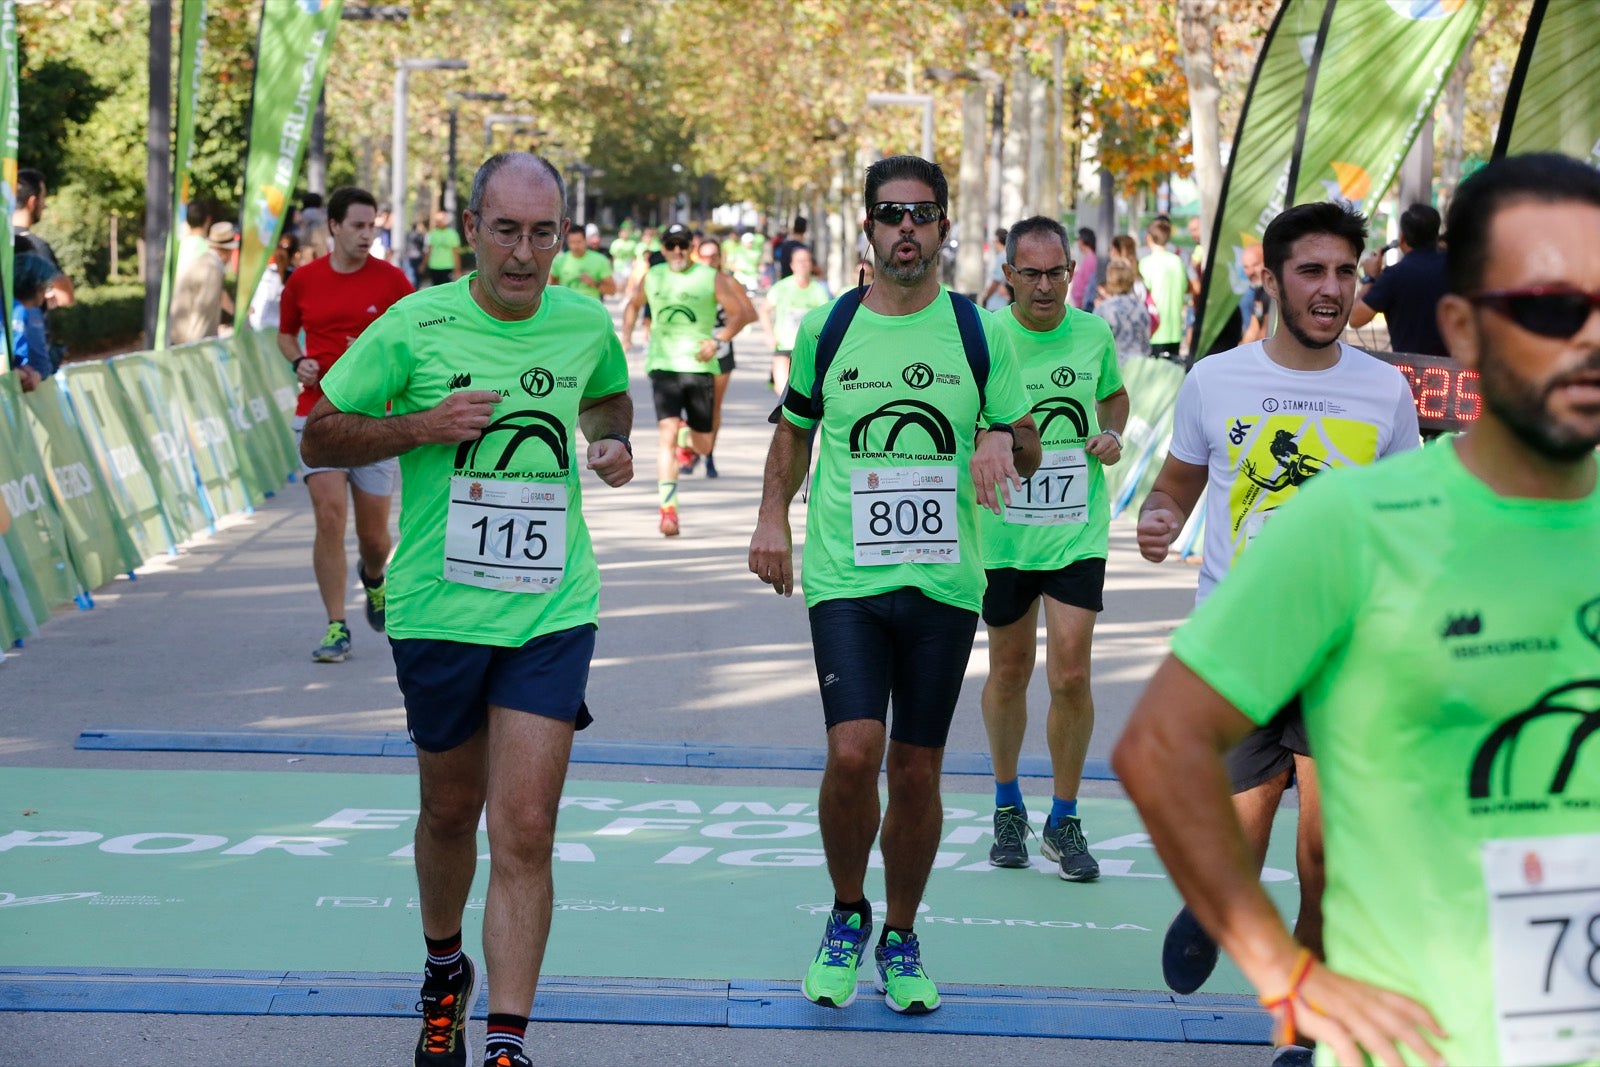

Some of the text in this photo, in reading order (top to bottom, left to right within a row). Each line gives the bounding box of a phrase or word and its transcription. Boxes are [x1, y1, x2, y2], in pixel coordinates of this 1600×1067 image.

[418, 315, 446, 329] luanvi
[556, 381, 578, 389] MUJER
[842, 380, 893, 391] IBERDROLA
[935, 378, 961, 386] MUJER
[1282, 399, 1324, 412] STAMPALO
[1228, 419, 1252, 446] 6K
[464, 470, 496, 479] FORMA
[1021, 474, 1075, 504] 117
[869, 498, 943, 537] 808
[471, 515, 548, 561] 115
[555, 905, 665, 913] JOVEN
